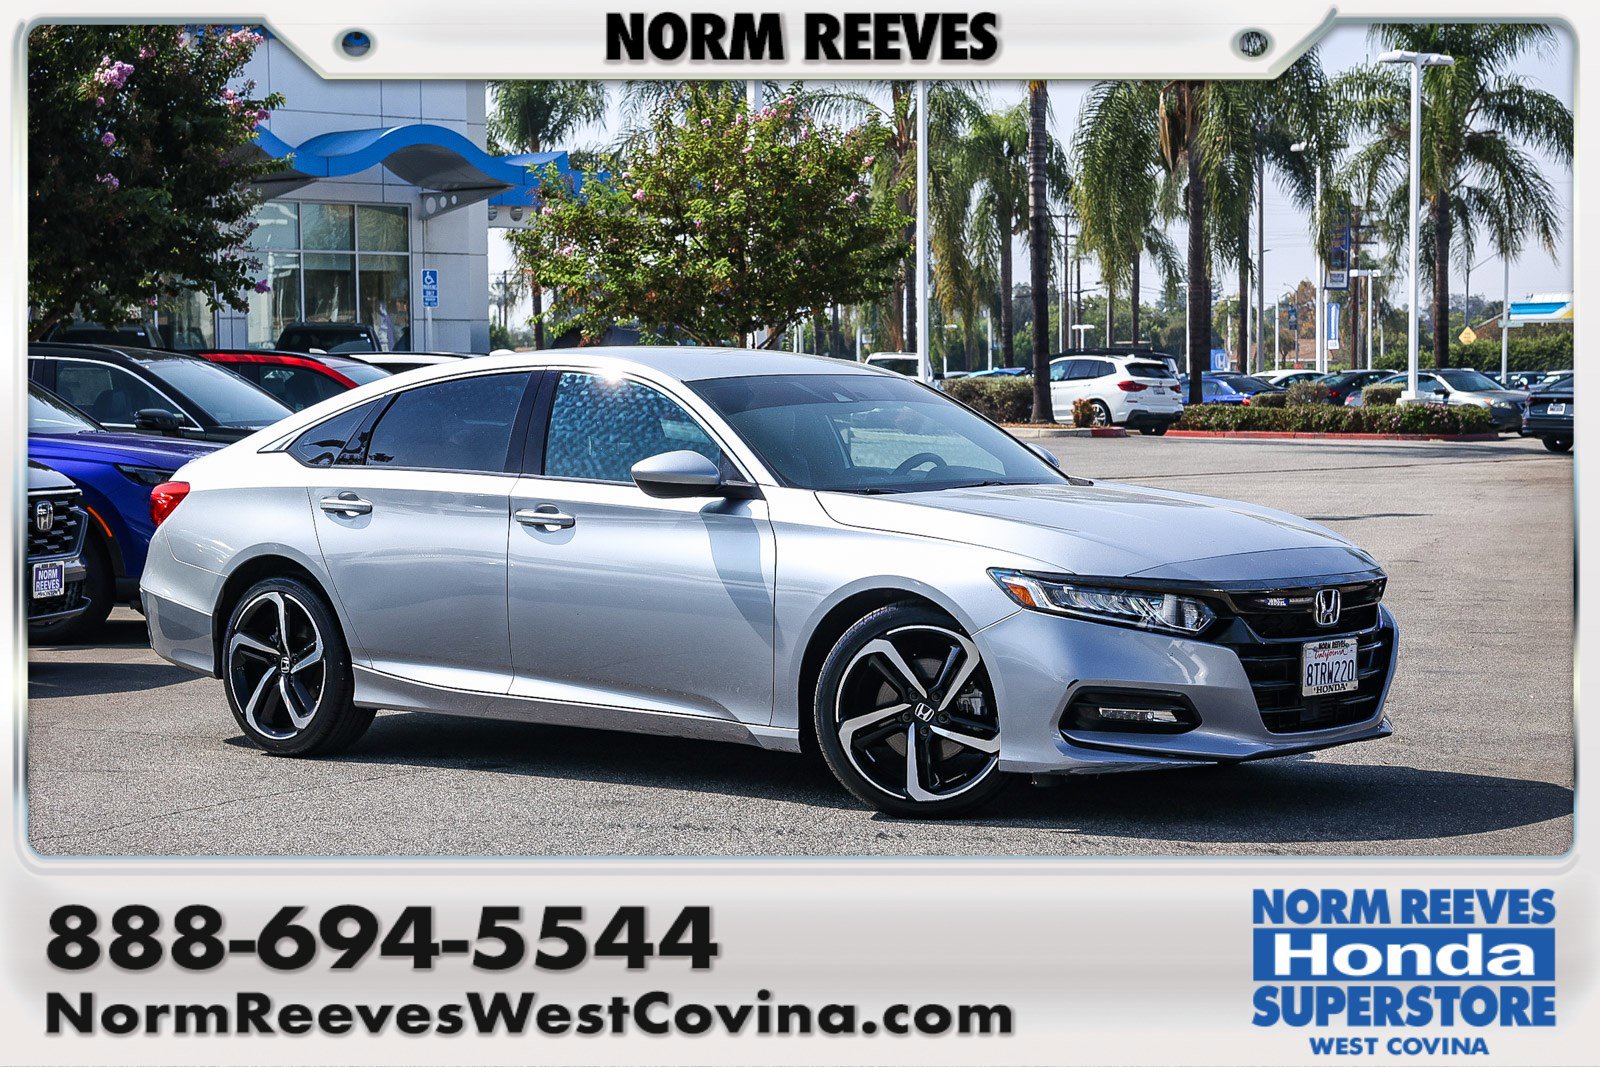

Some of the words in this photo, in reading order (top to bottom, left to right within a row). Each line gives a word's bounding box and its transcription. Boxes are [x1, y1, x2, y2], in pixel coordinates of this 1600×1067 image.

[38, 569, 58, 580] NORM
[35, 579, 60, 591] REEVES
[1306, 660, 1354, 686] 8TRW220
[1316, 683, 1346, 693] HONDA
